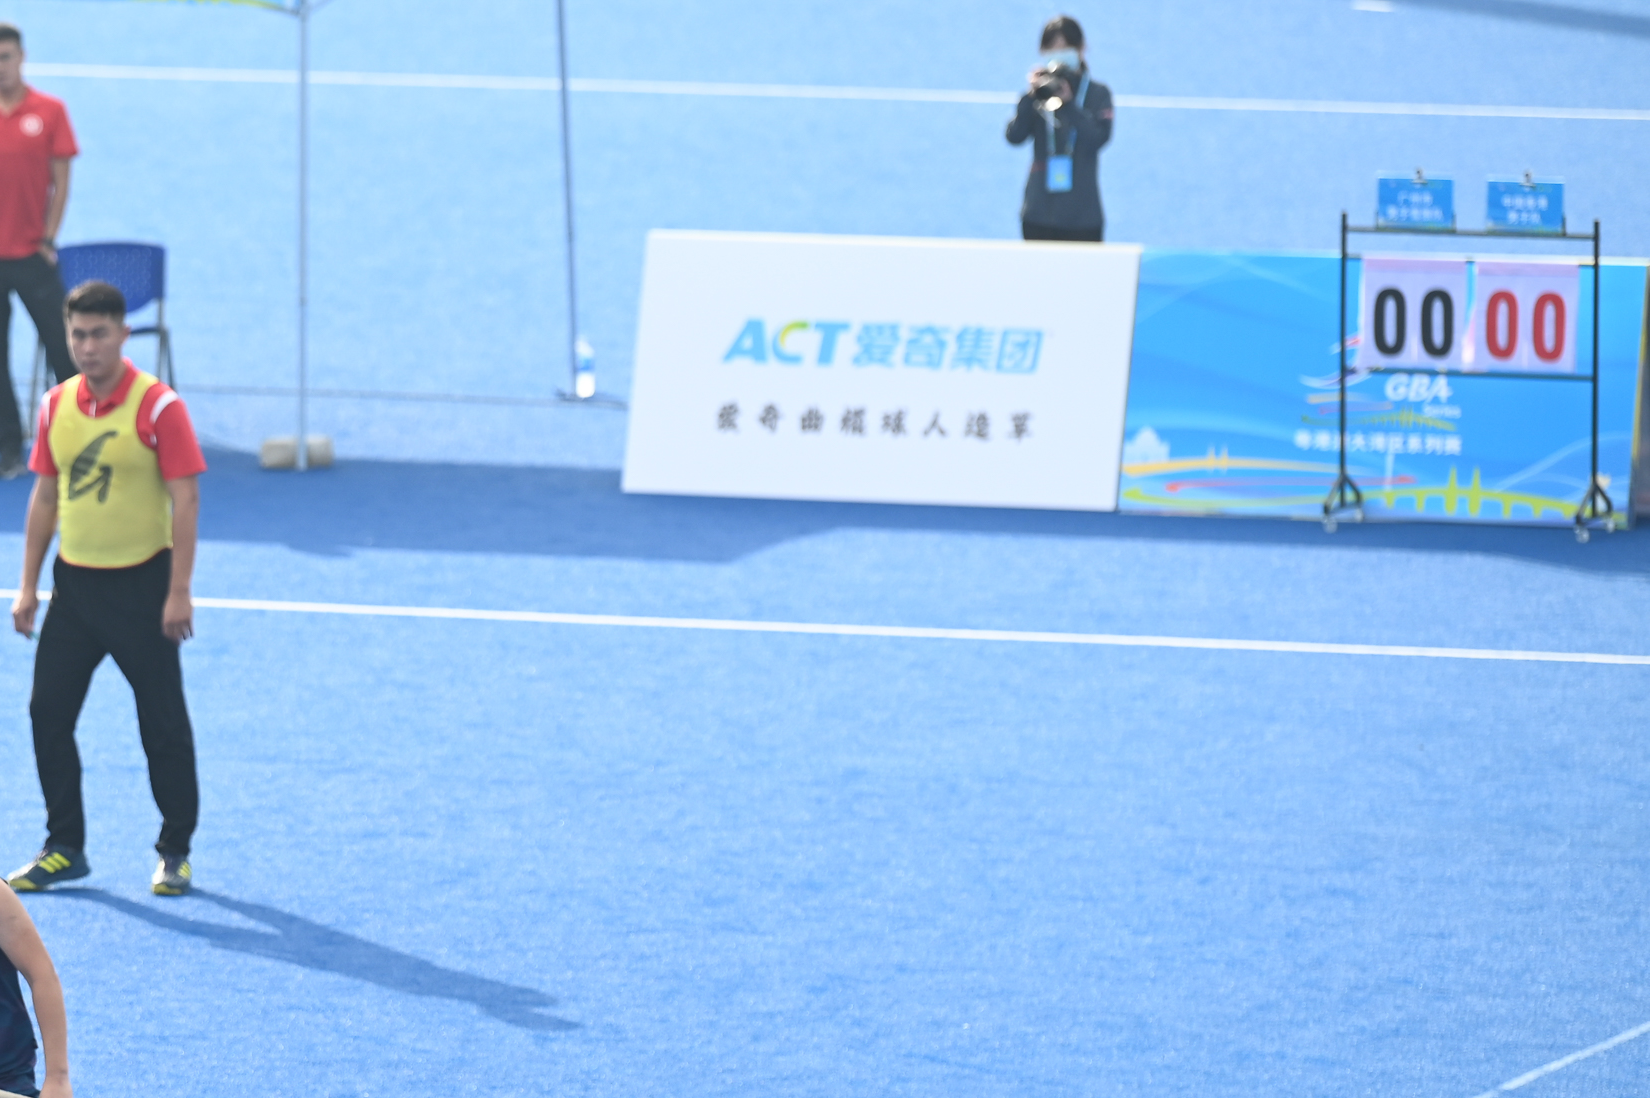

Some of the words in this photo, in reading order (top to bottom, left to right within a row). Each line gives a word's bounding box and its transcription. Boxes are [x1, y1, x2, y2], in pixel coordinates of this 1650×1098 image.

[1374, 287, 1454, 358] 00
[1486, 289, 1566, 363] 00
[1384, 373, 1454, 403] GBA
